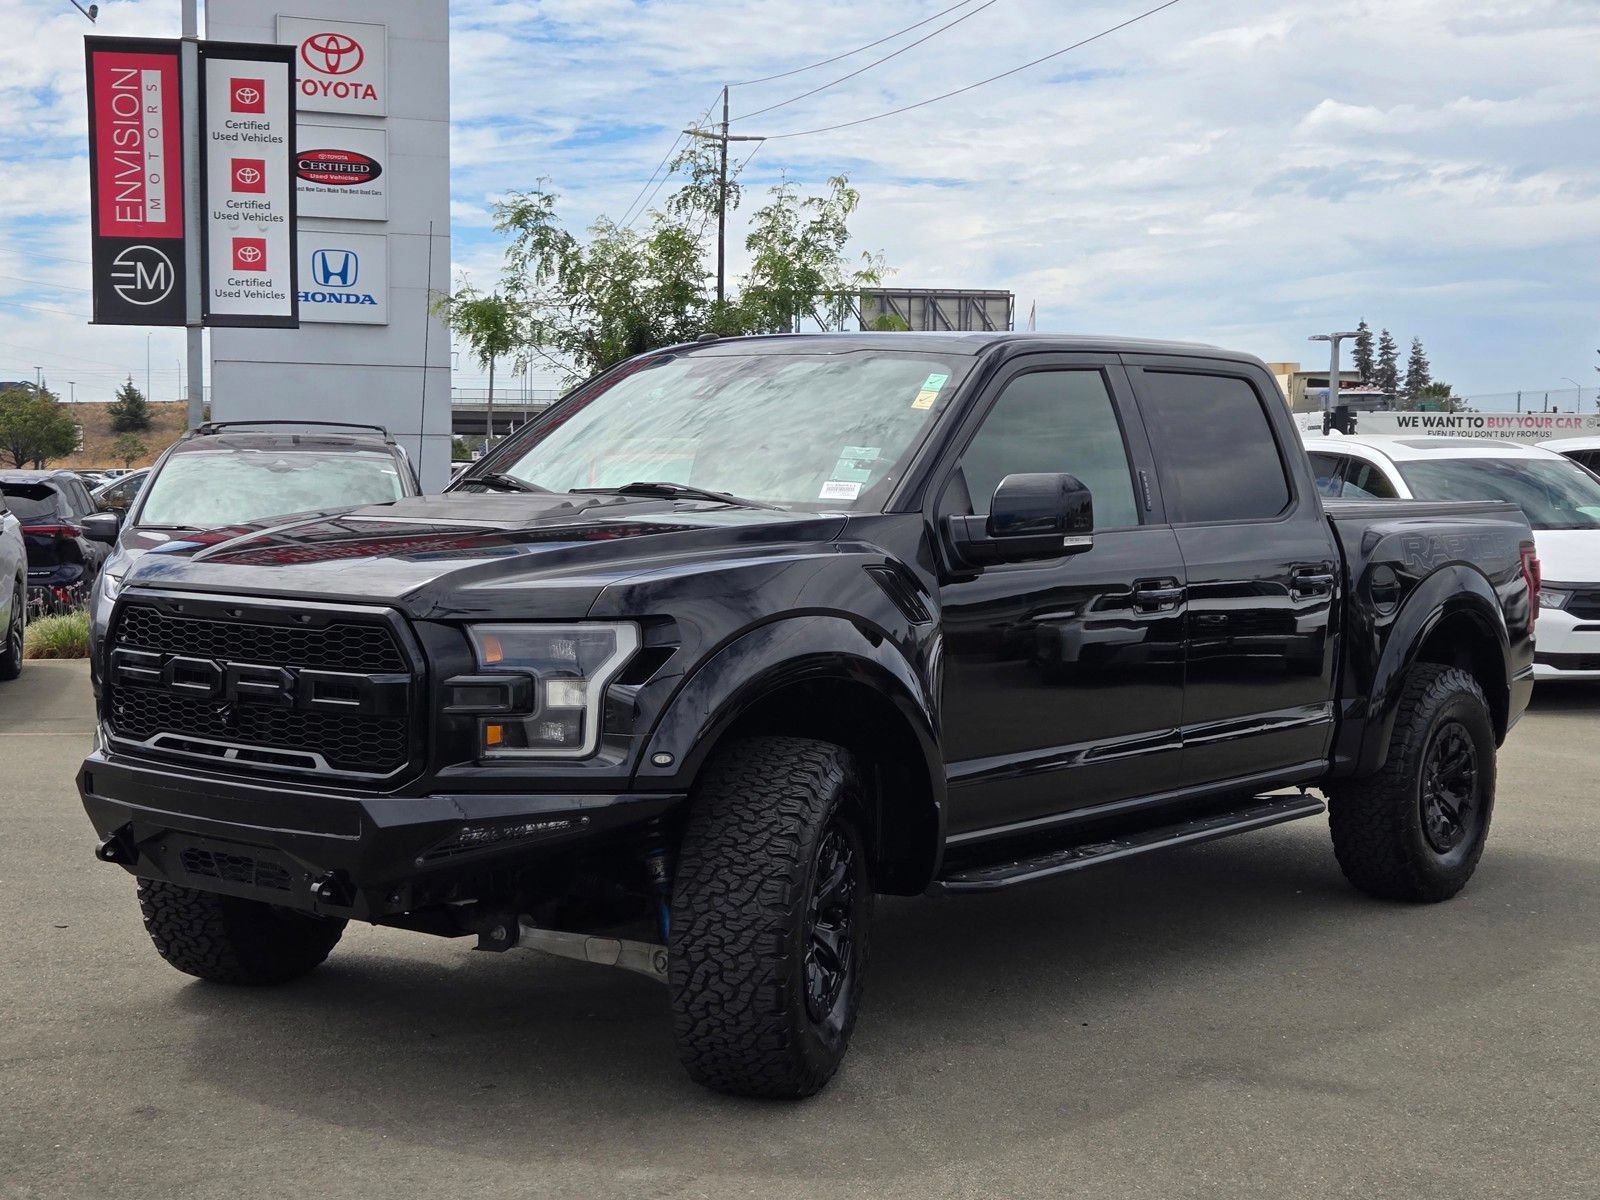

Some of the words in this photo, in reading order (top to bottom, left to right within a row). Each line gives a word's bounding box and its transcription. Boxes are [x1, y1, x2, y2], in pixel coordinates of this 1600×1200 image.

[225, 120, 270, 130] Certified
[212, 132, 239, 141] Used
[241, 133, 283, 143] Vehicles
[110, 68, 143, 223] ENVISION
[146, 83, 162, 210] MOTORS
[298, 160, 370, 173] CERTIFIED
[226, 200, 271, 210] Certified
[213, 211, 239, 220] Used
[242, 212, 284, 222] Vehicles
[227, 278, 272, 287] Certified
[215, 289, 241, 298] Used
[243, 290, 286, 300] Vehicles
[297, 292, 378, 305] HONDA
[1397, 416, 1419, 427] WE
[1422, 416, 1464, 427] WANT
[1466, 417, 1484, 428] TO
[1487, 417, 1514, 428] BUY
[1516, 417, 1552, 428] YOUR
[1555, 418, 1582, 428] CAR
[111, 648, 376, 713] FORD
